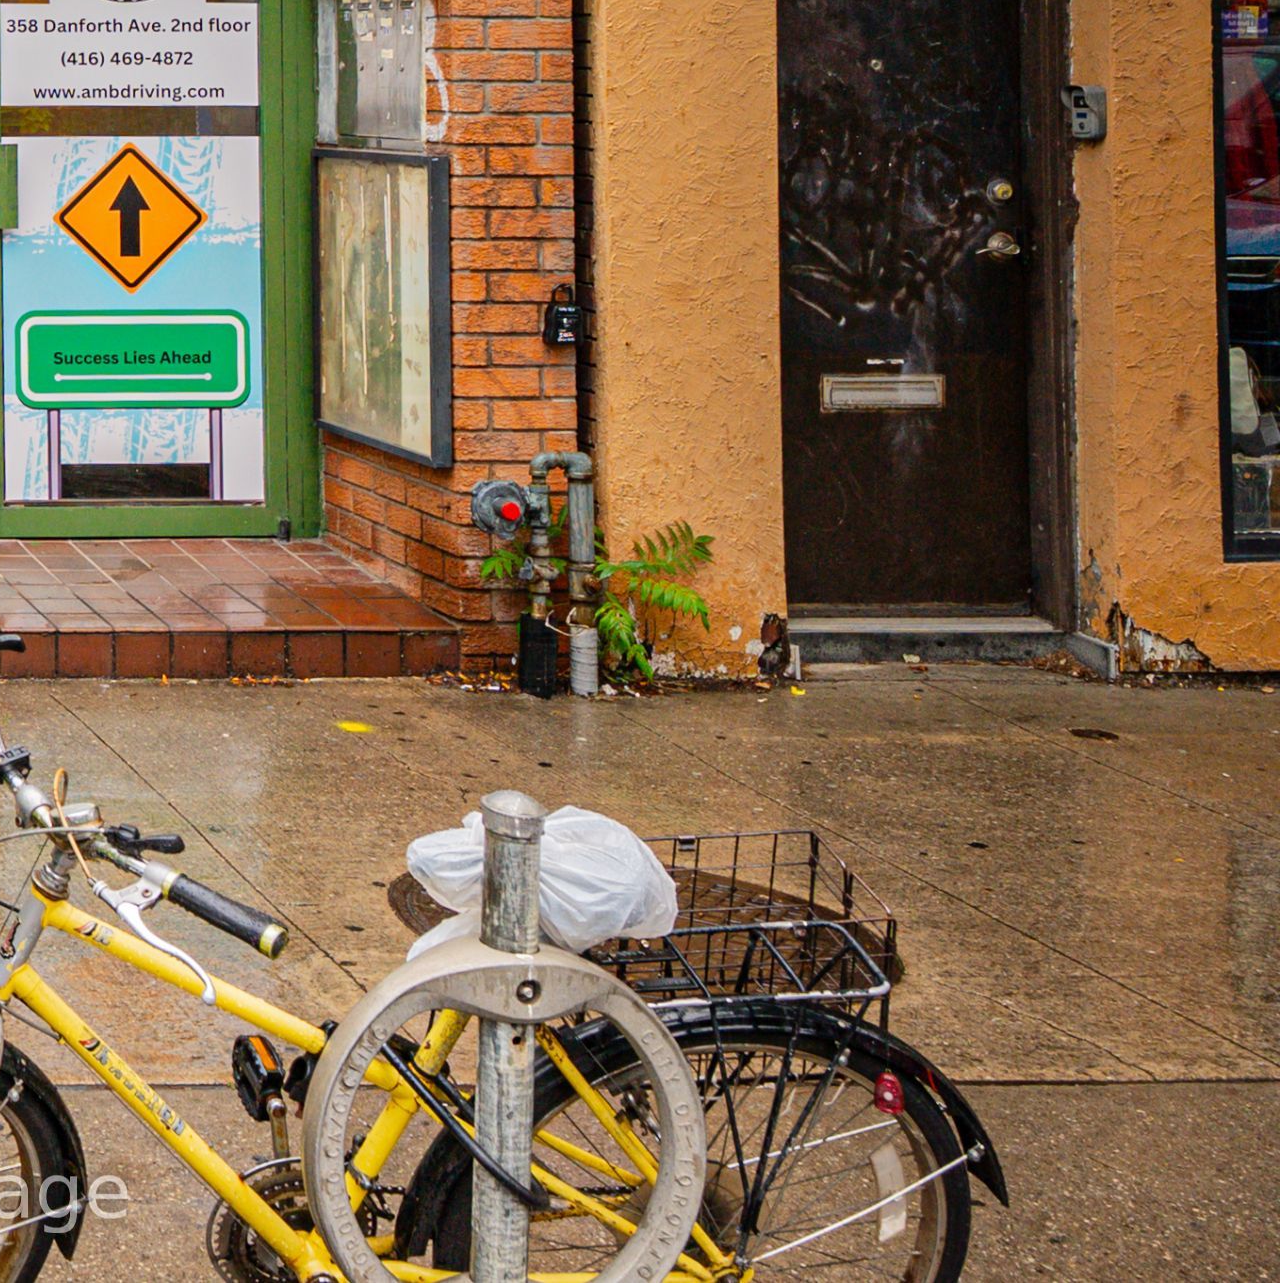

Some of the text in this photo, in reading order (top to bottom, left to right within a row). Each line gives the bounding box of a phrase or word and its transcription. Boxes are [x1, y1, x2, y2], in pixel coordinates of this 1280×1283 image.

[6, 18, 251, 33] 358 Danforth Ave. 2nd floor
[61, 51, 193, 67] (416) 469-4872
[33, 84, 225, 102] www.ambdriving.com
[53, 350, 212, 366] Success Lies Ahead
